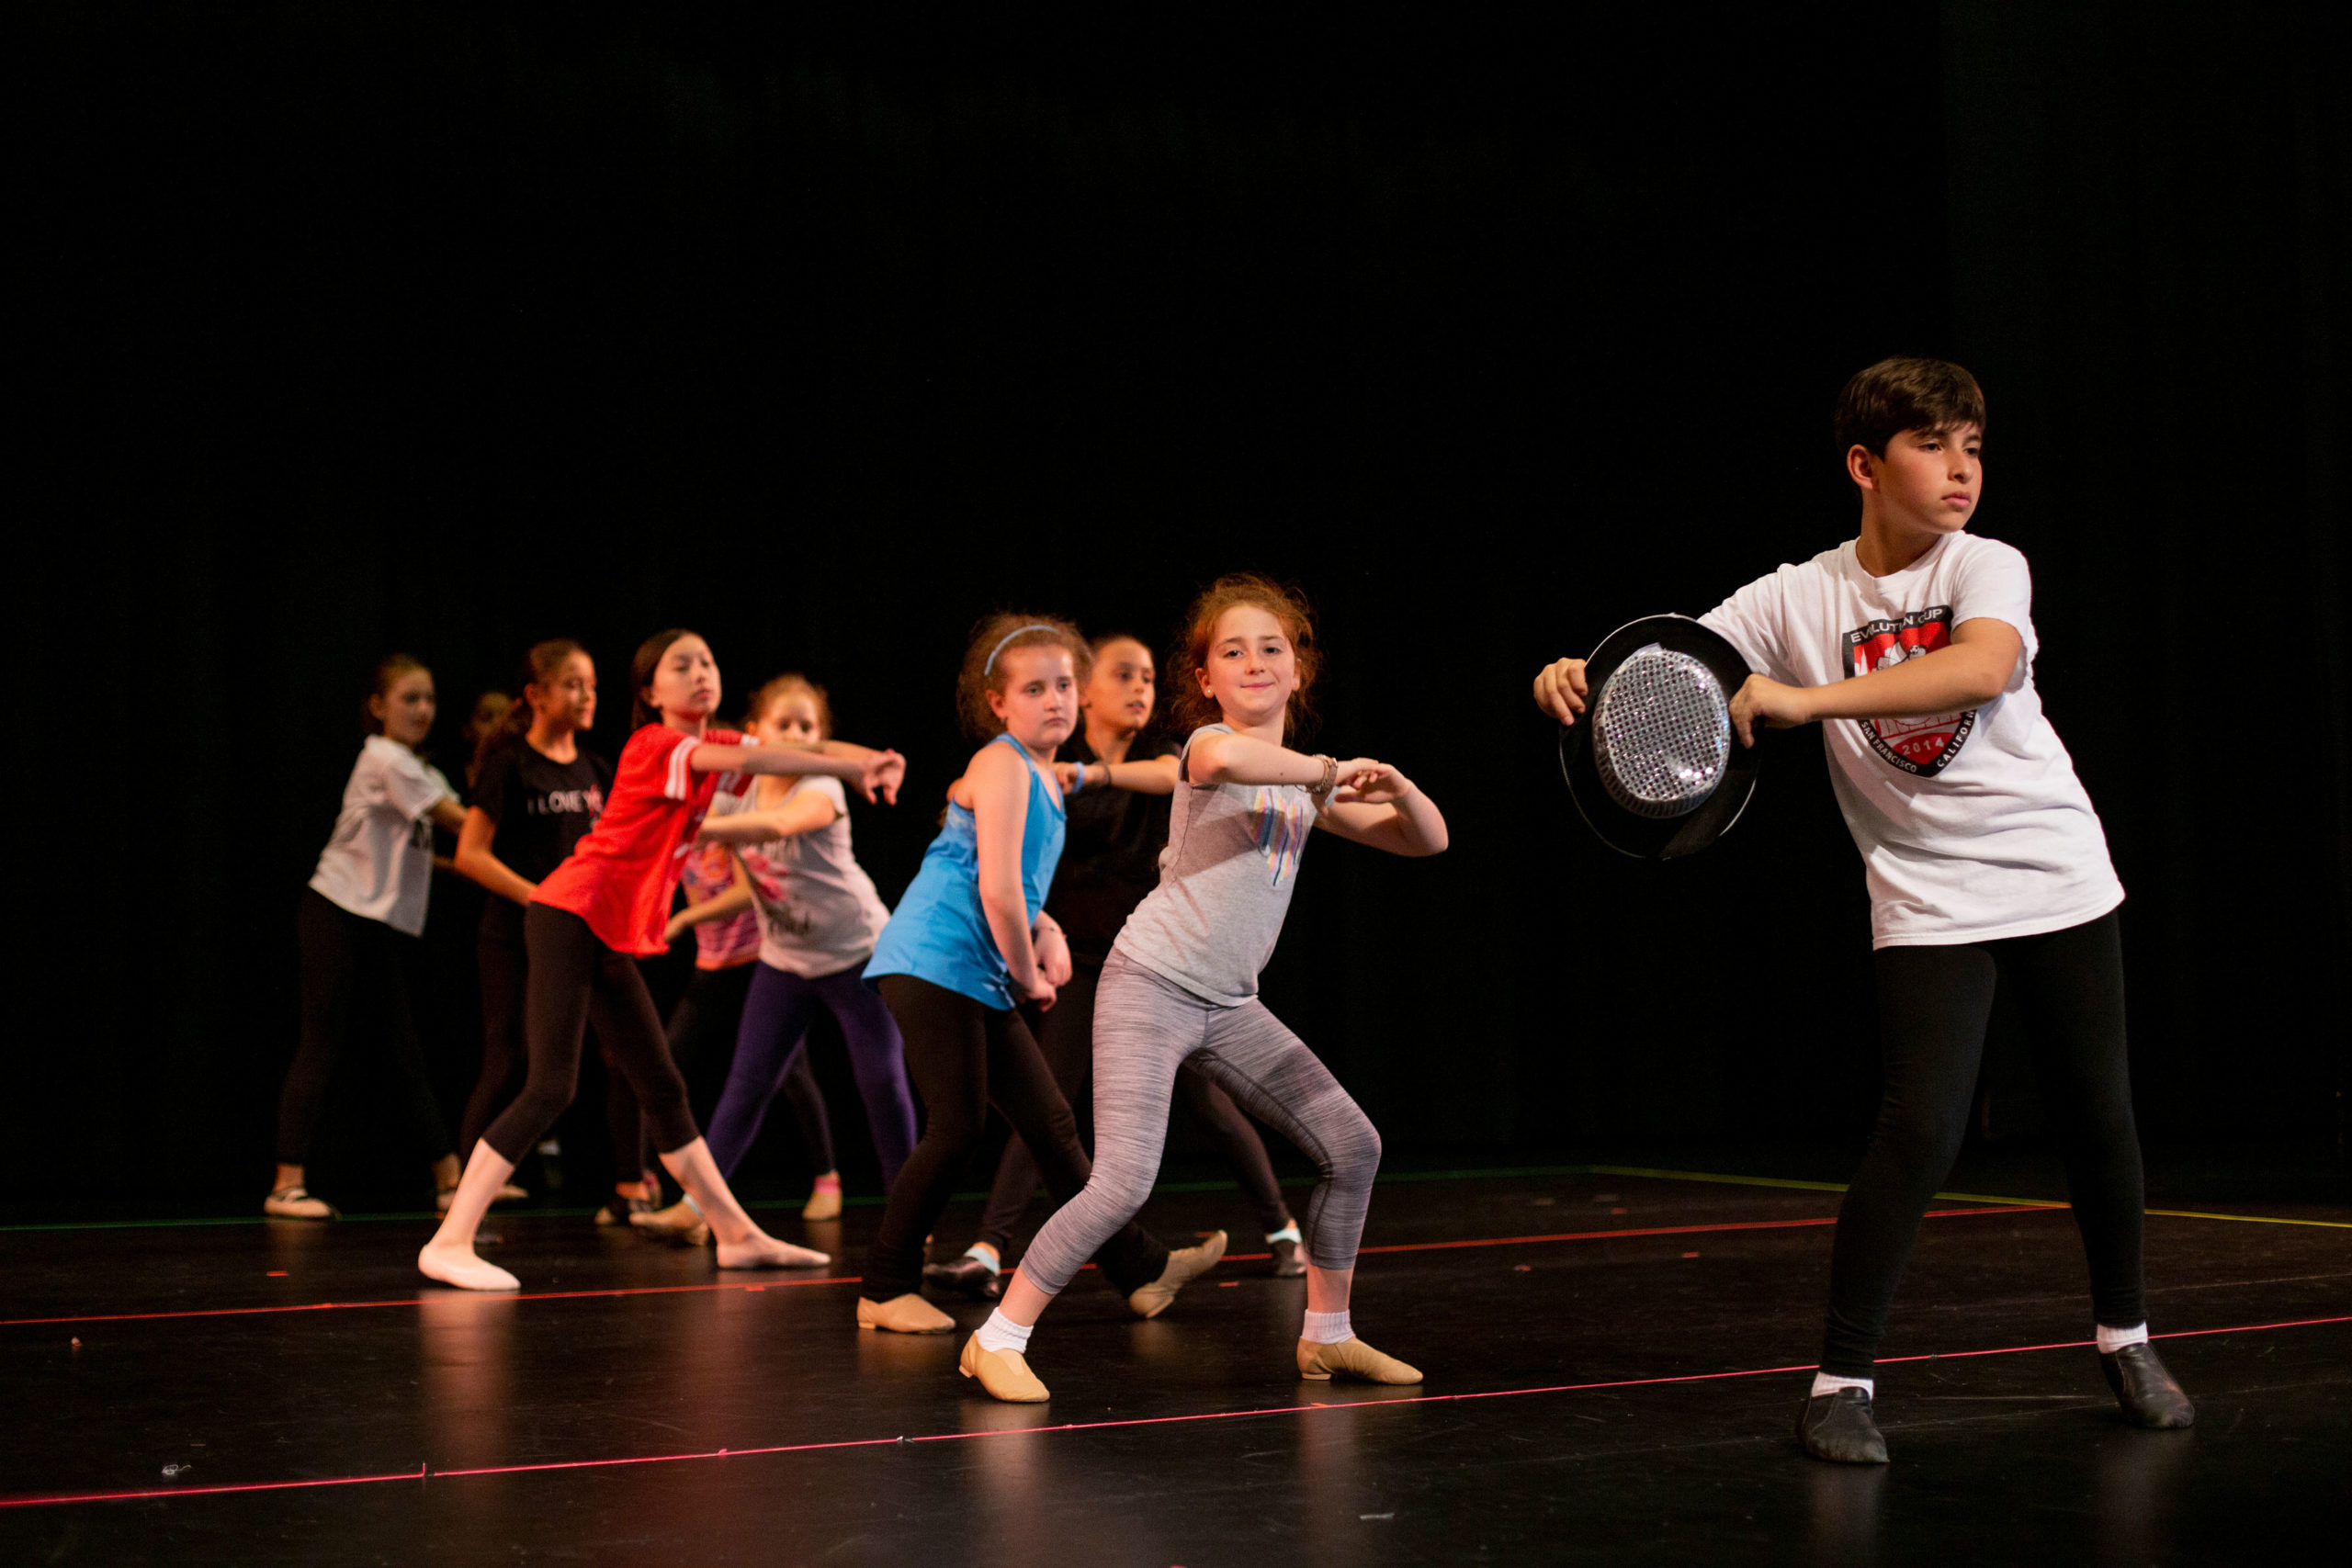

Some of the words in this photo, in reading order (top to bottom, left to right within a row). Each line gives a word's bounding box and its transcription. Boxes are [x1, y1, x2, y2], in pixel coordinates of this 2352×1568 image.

[1917, 608, 1943, 624] CUP
[1861, 721, 1875, 740] SAN
[1872, 739, 1917, 773] FRANCISCO
[1902, 737, 1944, 755] 2014
[537, 790, 582, 815] LOVE
